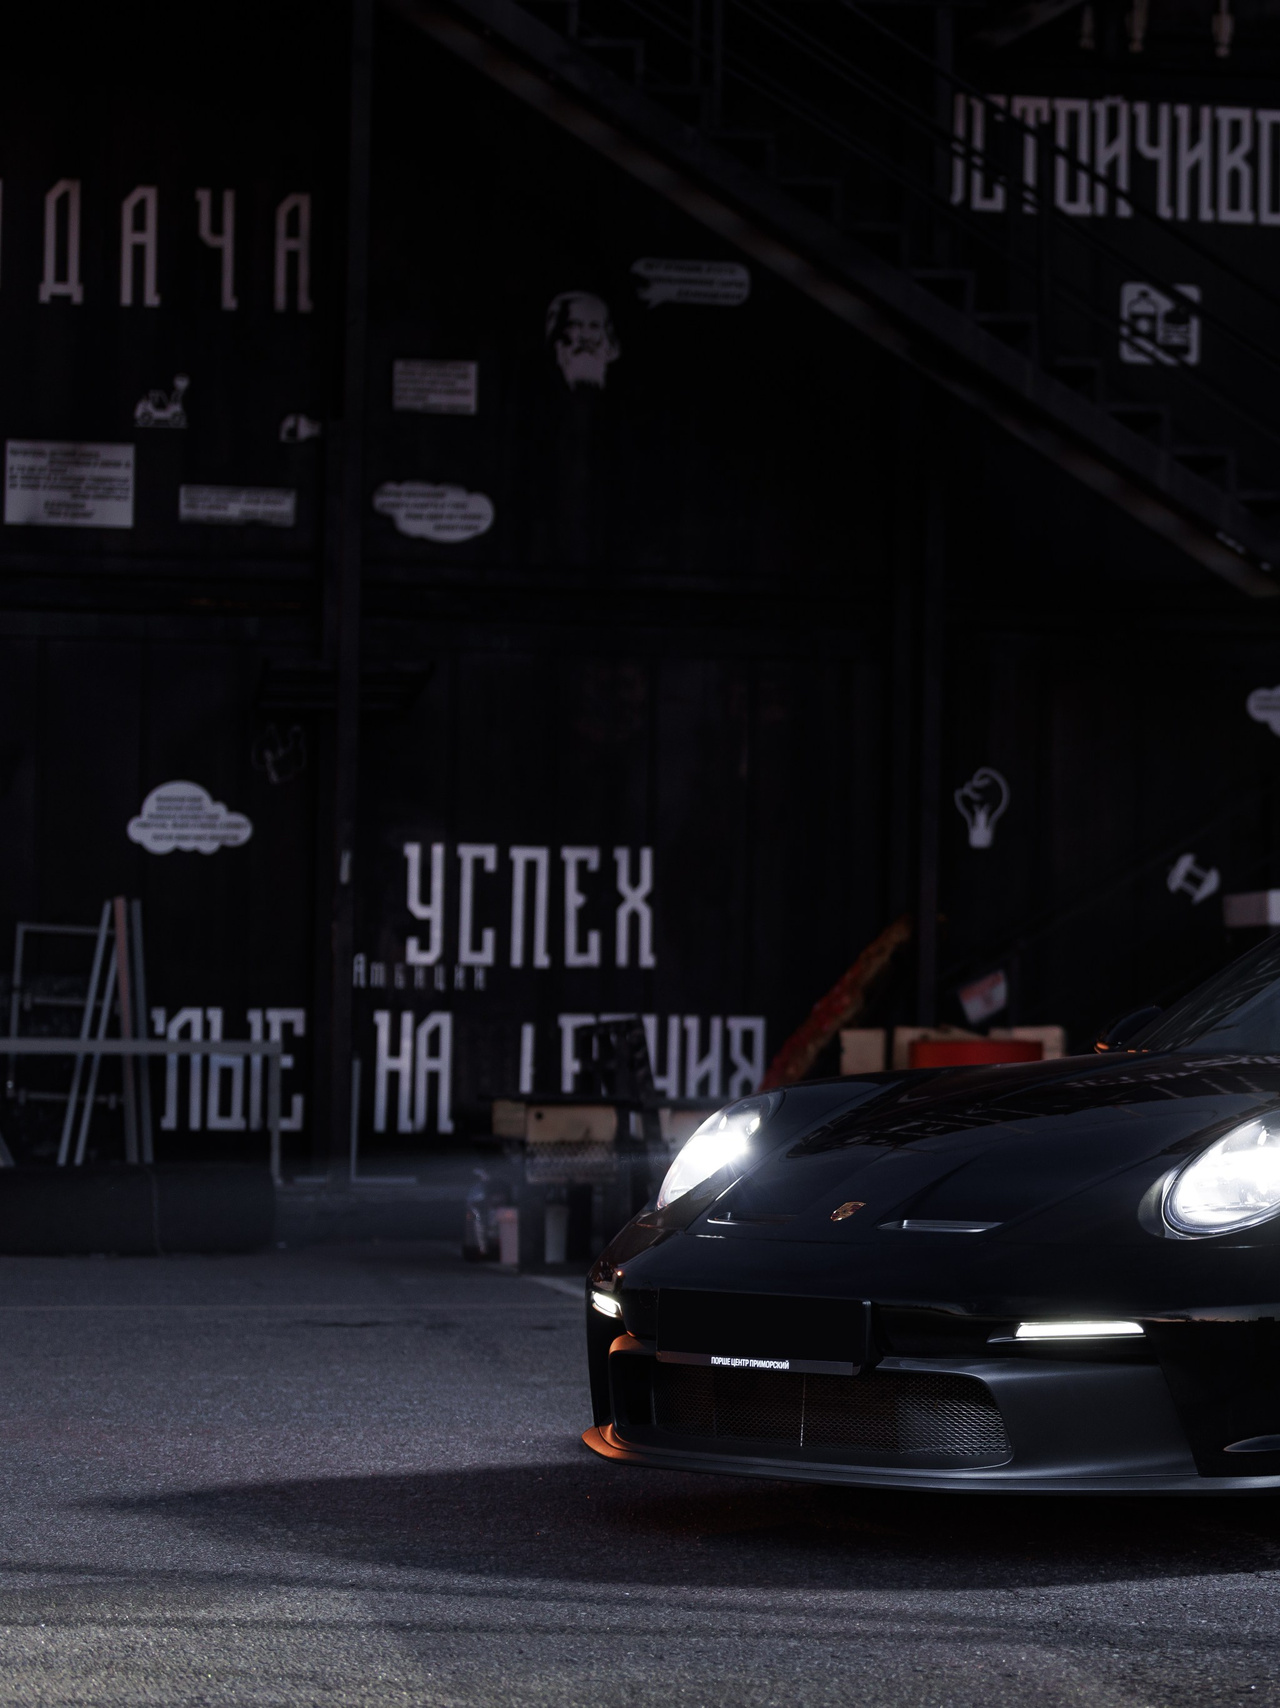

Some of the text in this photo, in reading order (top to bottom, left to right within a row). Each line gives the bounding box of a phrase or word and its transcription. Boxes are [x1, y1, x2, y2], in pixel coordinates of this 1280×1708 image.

[0, 176, 315, 314] ДАЧА
[402, 842, 657, 969] УСПЕХ
[151, 1006, 306, 1133] ЛЫЕ
[373, 1009, 456, 1134] НА
[710, 1356, 790, 1369] ПОРШЕ ЦЕНТР ПРИМОРСКИЙ
